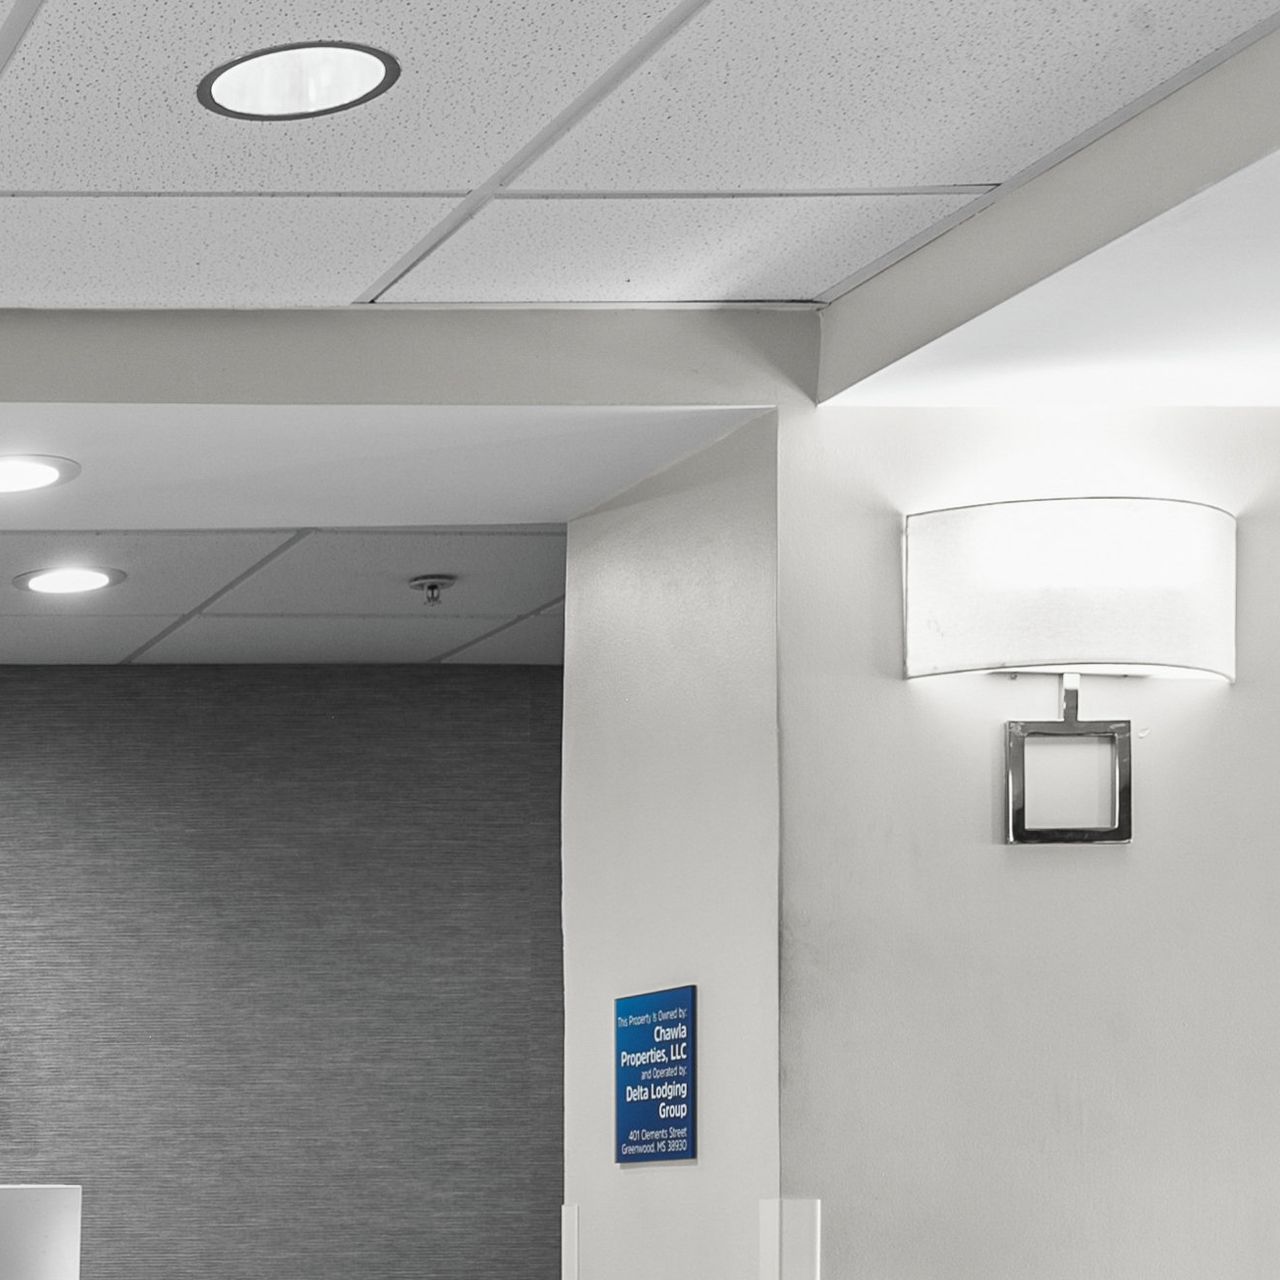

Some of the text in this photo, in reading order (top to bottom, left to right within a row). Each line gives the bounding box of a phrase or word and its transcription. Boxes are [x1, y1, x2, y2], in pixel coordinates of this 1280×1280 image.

[658, 1008, 677, 1021] Owned
[654, 1023, 687, 1042] Chawla
[621, 1042, 687, 1067] Properties, LLC
[641, 1069, 652, 1080] and
[653, 1066, 678, 1079] Operated
[626, 1081, 687, 1102] Delta Lodging
[659, 1102, 687, 1119] Group
[669, 1126, 687, 1138] Street
